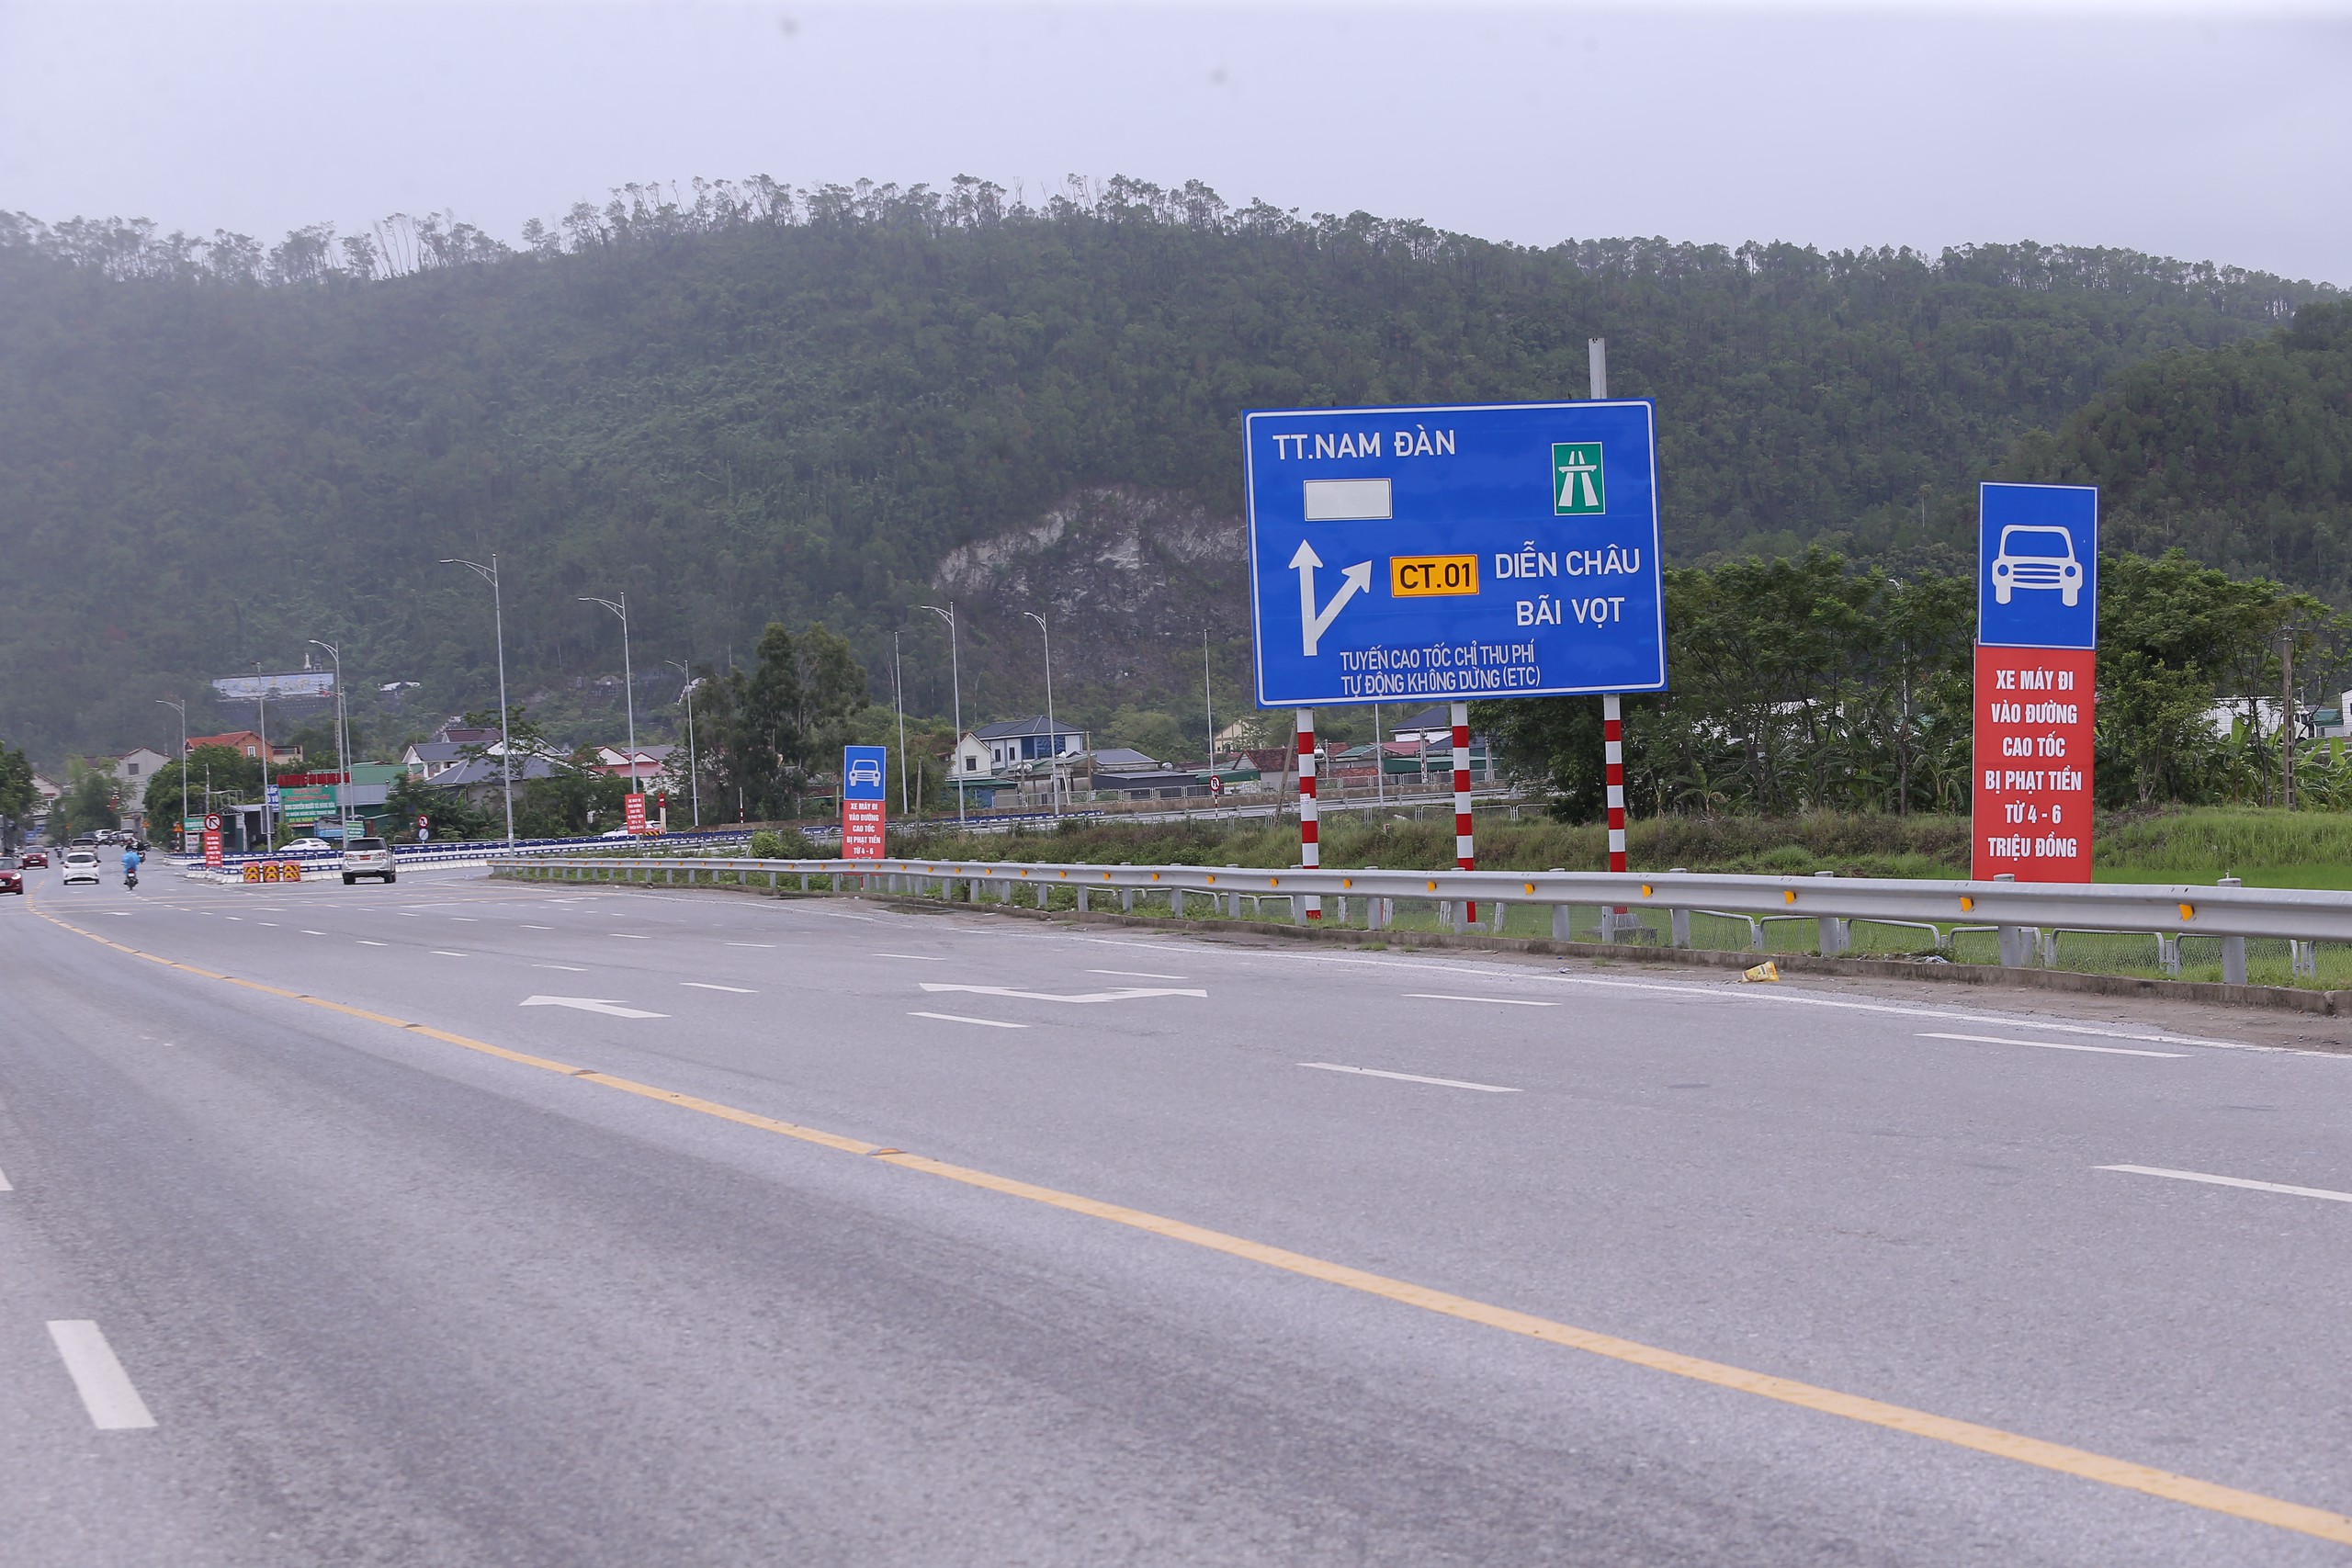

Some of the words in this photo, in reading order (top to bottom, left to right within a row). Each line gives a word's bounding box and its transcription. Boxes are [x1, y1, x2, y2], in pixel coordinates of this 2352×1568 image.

[1272, 433, 1382, 460] TT.NAM
[1394, 424, 1455, 457] ĐÀN
[1495, 540, 1557, 580] DIỄN
[1566, 544, 1641, 576] CHÂU
[1399, 563, 1471, 591] CT.01
[1516, 594, 1561, 626] BÃI
[1571, 597, 1625, 629] VỌT
[1340, 645, 1389, 671] TUYẾN
[1391, 650, 1419, 669] CAO
[1422, 642, 1452, 668] TỐC
[1454, 640, 1477, 666] CHỈ
[1480, 646, 1510, 665] THU
[1511, 638, 1535, 663] PHÍ
[1341, 675, 1361, 697] TỰ
[1364, 671, 1404, 695] ĐỘNG
[1408, 669, 1456, 694] KHÔNG
[1459, 667, 1500, 689] DỪNG
[1502, 665, 1541, 688] (ETC)
[1996, 670, 2015, 690] XE
[2020, 666, 2053, 690] MÁY
[2058, 671, 2074, 691] ĐI
[1991, 699, 2021, 723] VÀO
[2025, 699, 2077, 724] ĐƯỜNG
[2002, 737, 2032, 757] CAO
[2037, 730, 2065, 757] TỐC
[1984, 770, 2001, 794] BỊ
[2005, 770, 2044, 795] PHẠT
[2048, 764, 2082, 791] TIỀN
[859, 802, 871, 810] MÁY
[2005, 800, 2025, 824] TỪ
[2028, 804, 2037, 824] 4
[2052, 804, 2062, 824] 6
[1987, 833, 2031, 862] TRIỆU
[2035, 831, 2077, 858] ĐỒNG
